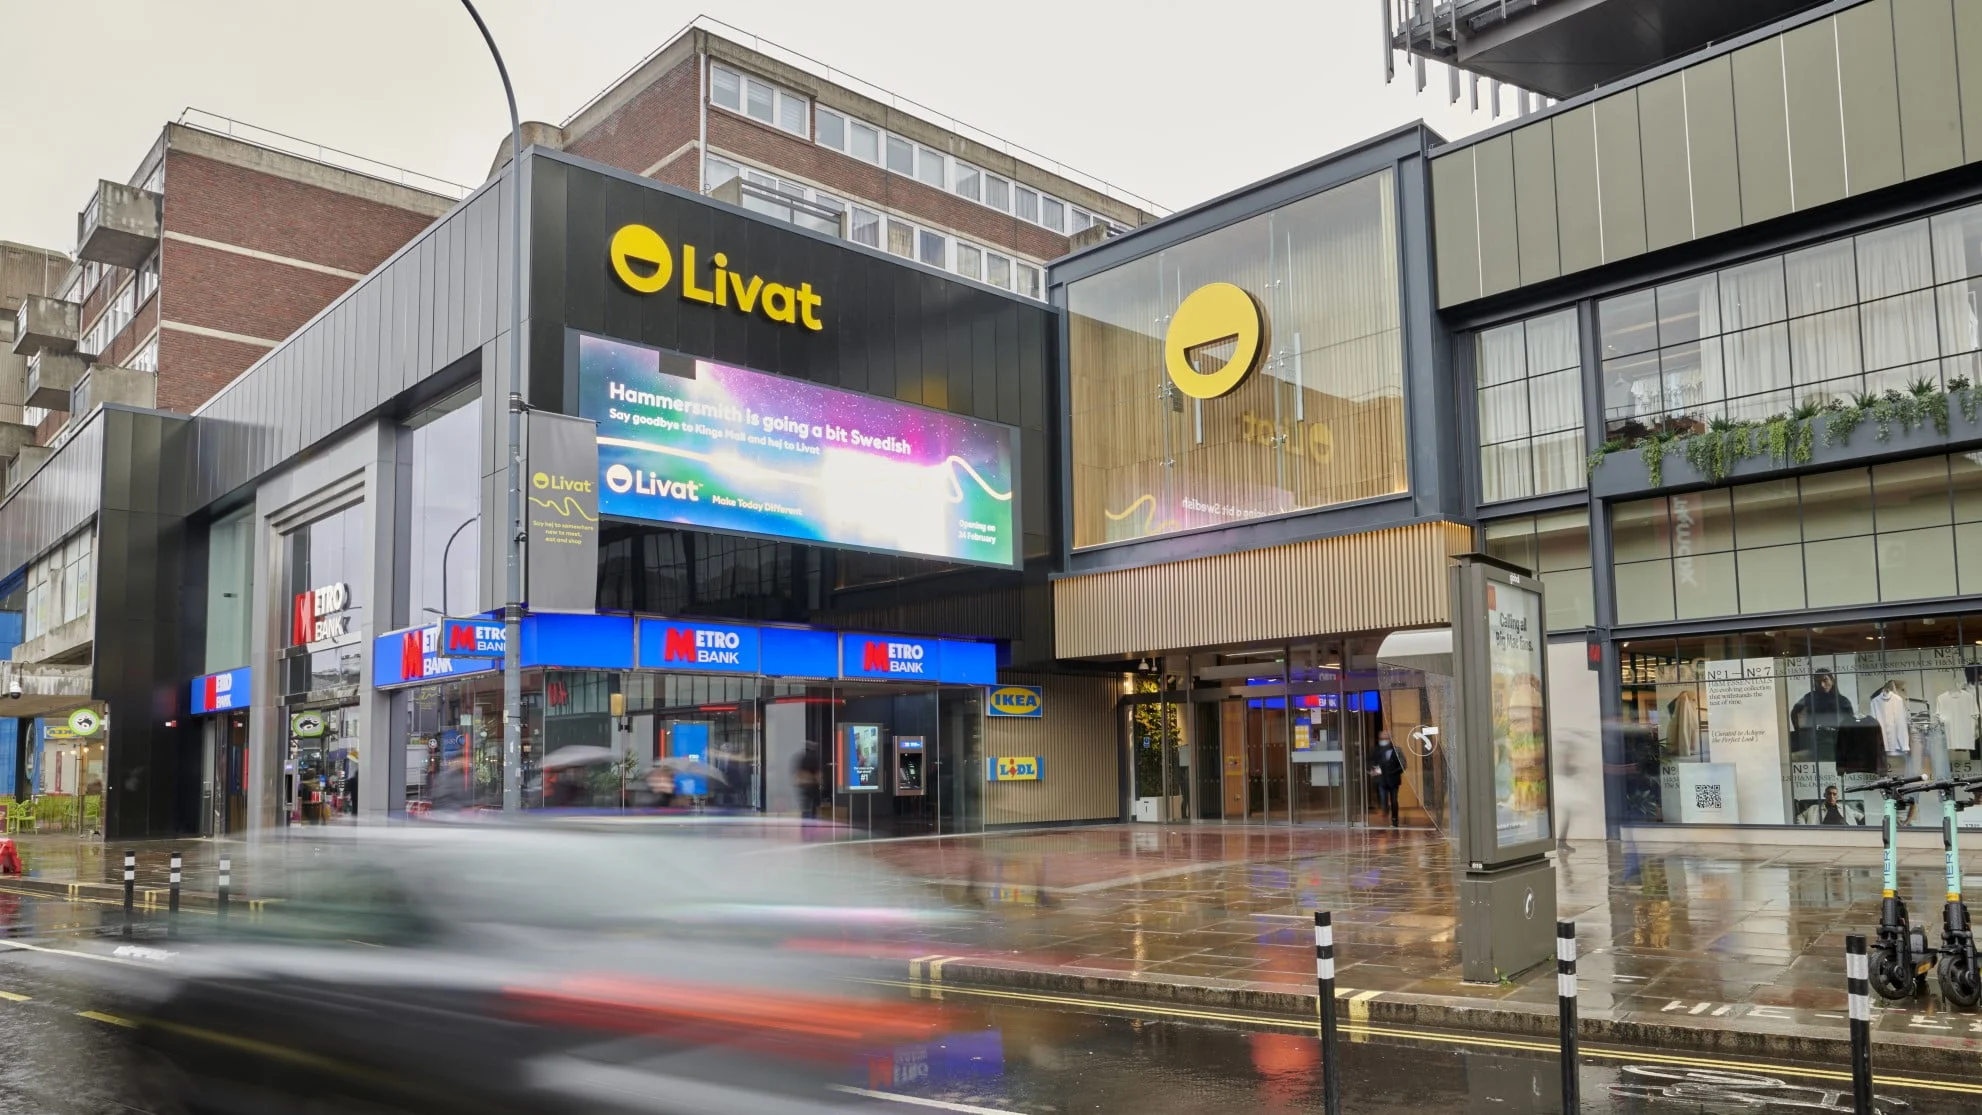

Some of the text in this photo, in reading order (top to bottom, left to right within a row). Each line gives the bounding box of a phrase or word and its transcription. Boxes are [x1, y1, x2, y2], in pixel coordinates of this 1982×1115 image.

[683, 244, 823, 331] Livat
[609, 381, 912, 455] Hammersmith is going a bit Swedish
[609, 408, 631, 424] Say
[632, 412, 679, 431] goodbye
[682, 421, 694, 433] to
[695, 424, 723, 439] Kings
[725, 428, 746, 442] Mall
[748, 433, 767, 446] and
[784, 440, 795, 451] to
[796, 441, 820, 455] Livat
[552, 474, 591, 493] Livat
[635, 470, 699, 502] Livat
[712, 494, 737, 507] Make
[738, 498, 763, 512] Today
[293, 582, 345, 646] METRO
[315, 616, 344, 641] BANK
[1500, 612, 1520, 634] Calling
[477, 642, 506, 651] BAN
[664, 627, 740, 663] METRO
[698, 650, 740, 664] BANK
[863, 641, 924, 673] METRO
[424, 656, 453, 676] BANK
[890, 661, 924, 674] BANK
[994, 693, 1038, 707] IKEA
[1883, 850, 1891, 884] TIER
[1945, 852, 1953, 888] TIER
